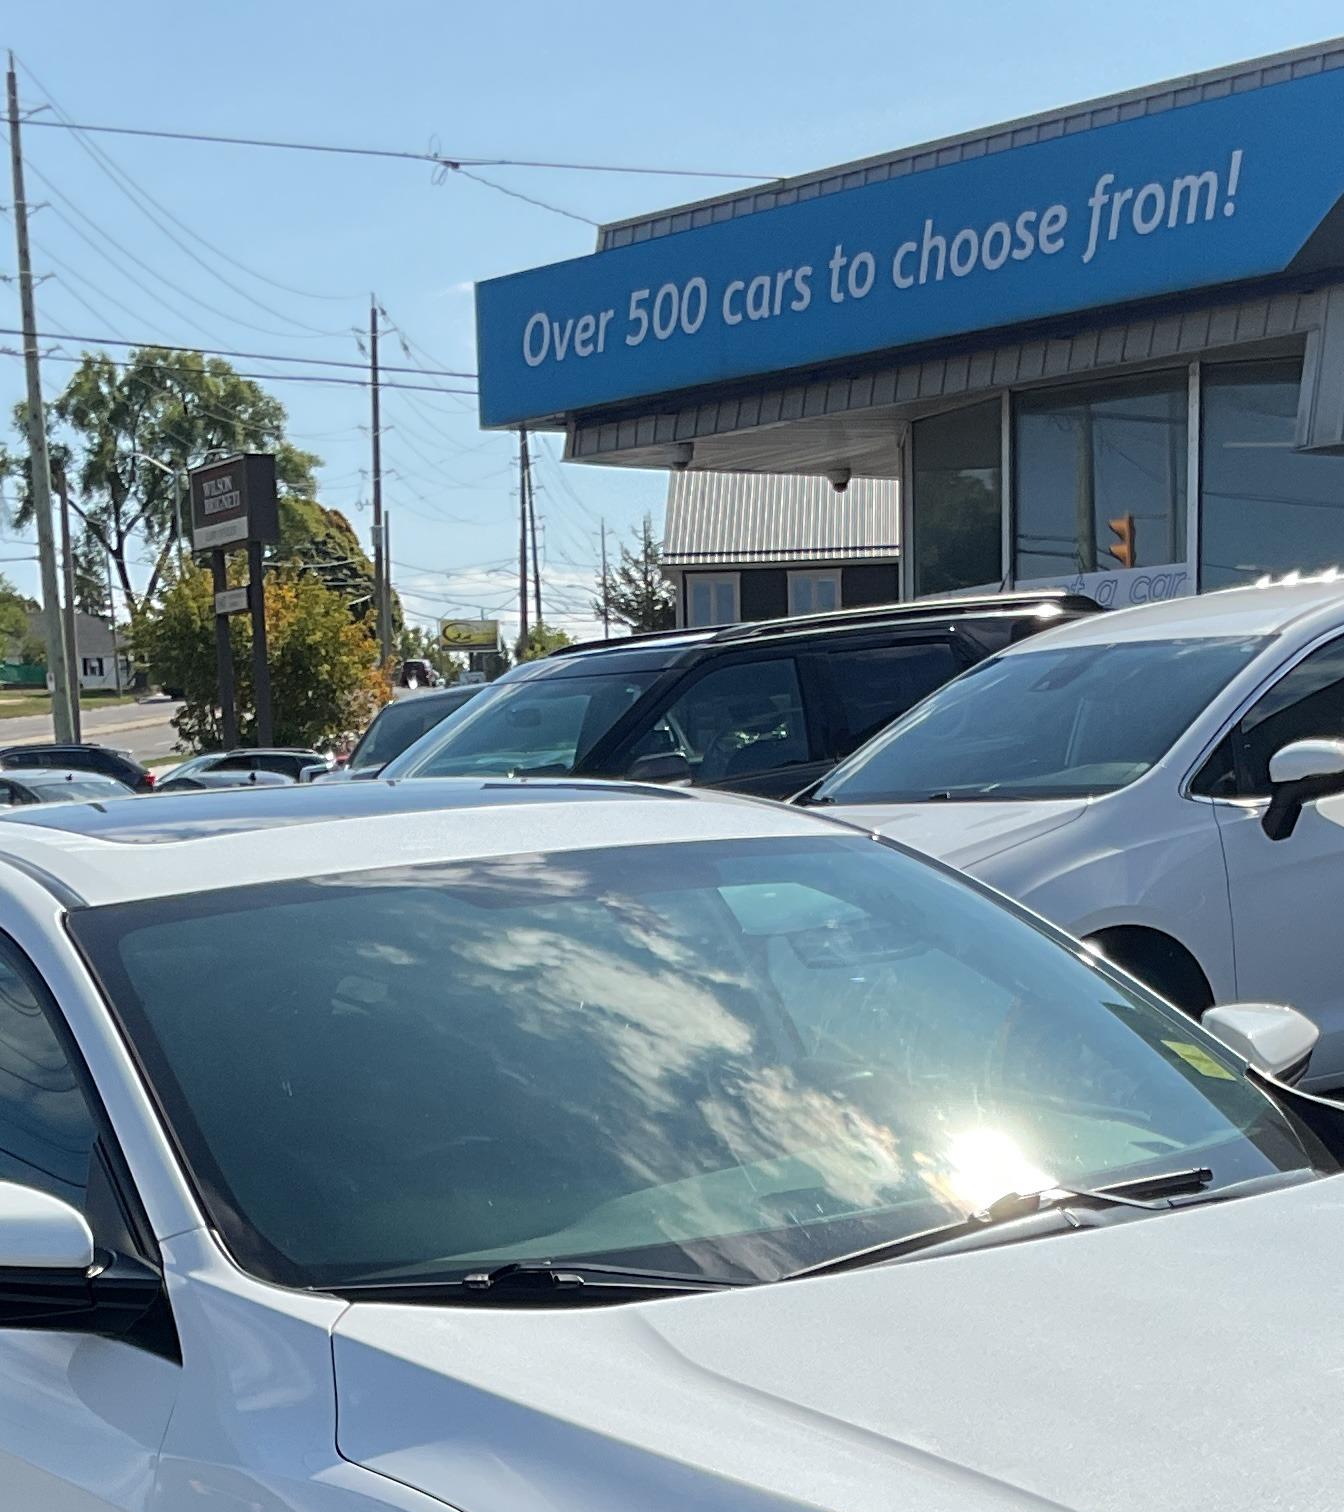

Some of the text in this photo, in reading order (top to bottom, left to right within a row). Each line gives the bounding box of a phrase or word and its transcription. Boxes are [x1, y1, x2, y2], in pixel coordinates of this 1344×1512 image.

[522, 150, 1243, 367] Over 500 cars to choose from!
[1094, 579, 1118, 606] a
[1129, 571, 1187, 605] car
